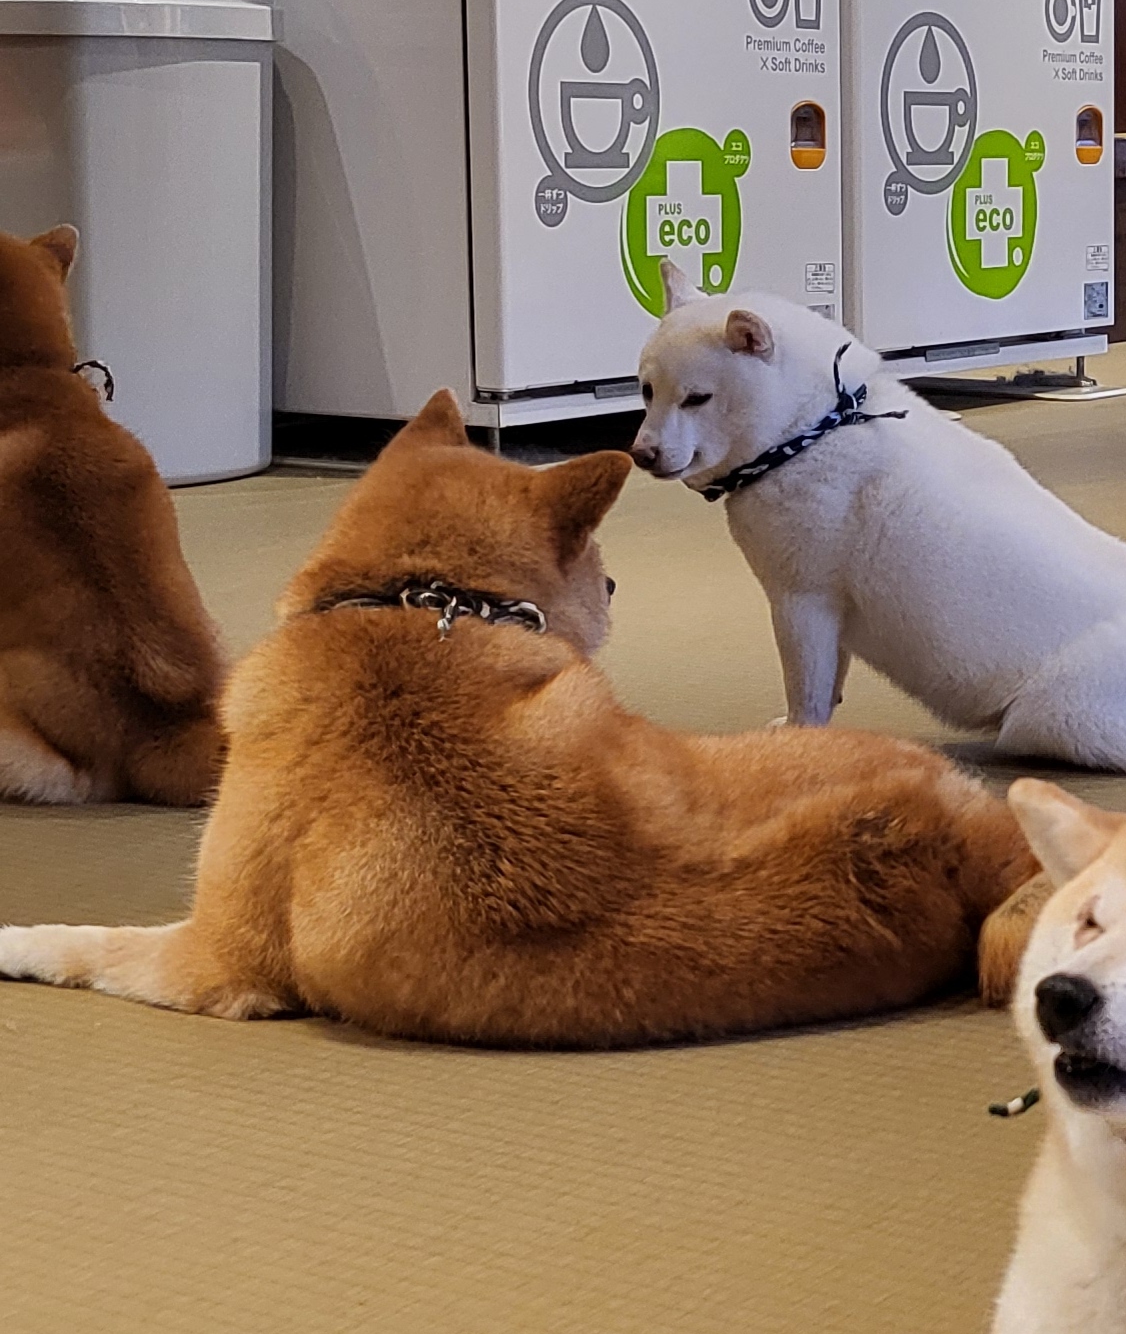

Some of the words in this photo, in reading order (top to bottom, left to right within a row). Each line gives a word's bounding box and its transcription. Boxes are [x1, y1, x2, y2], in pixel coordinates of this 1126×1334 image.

[746, 34, 791, 53] Premium
[794, 37, 826, 54] Coffee
[1043, 49, 1077, 63] Premium
[1079, 50, 1103, 65] Coffee
[771, 56, 792, 72] Soft
[794, 57, 826, 74] Drinks
[1061, 67, 1077, 81] Soft
[1079, 68, 1103, 82] Drinks
[538, 188, 565, 200] 一杯ずつ
[975, 194, 993, 206] PLUS
[540, 203, 563, 214] ドリップ
[658, 203, 682, 216] PLUS
[975, 208, 1014, 232] eco
[659, 218, 711, 247] eco
